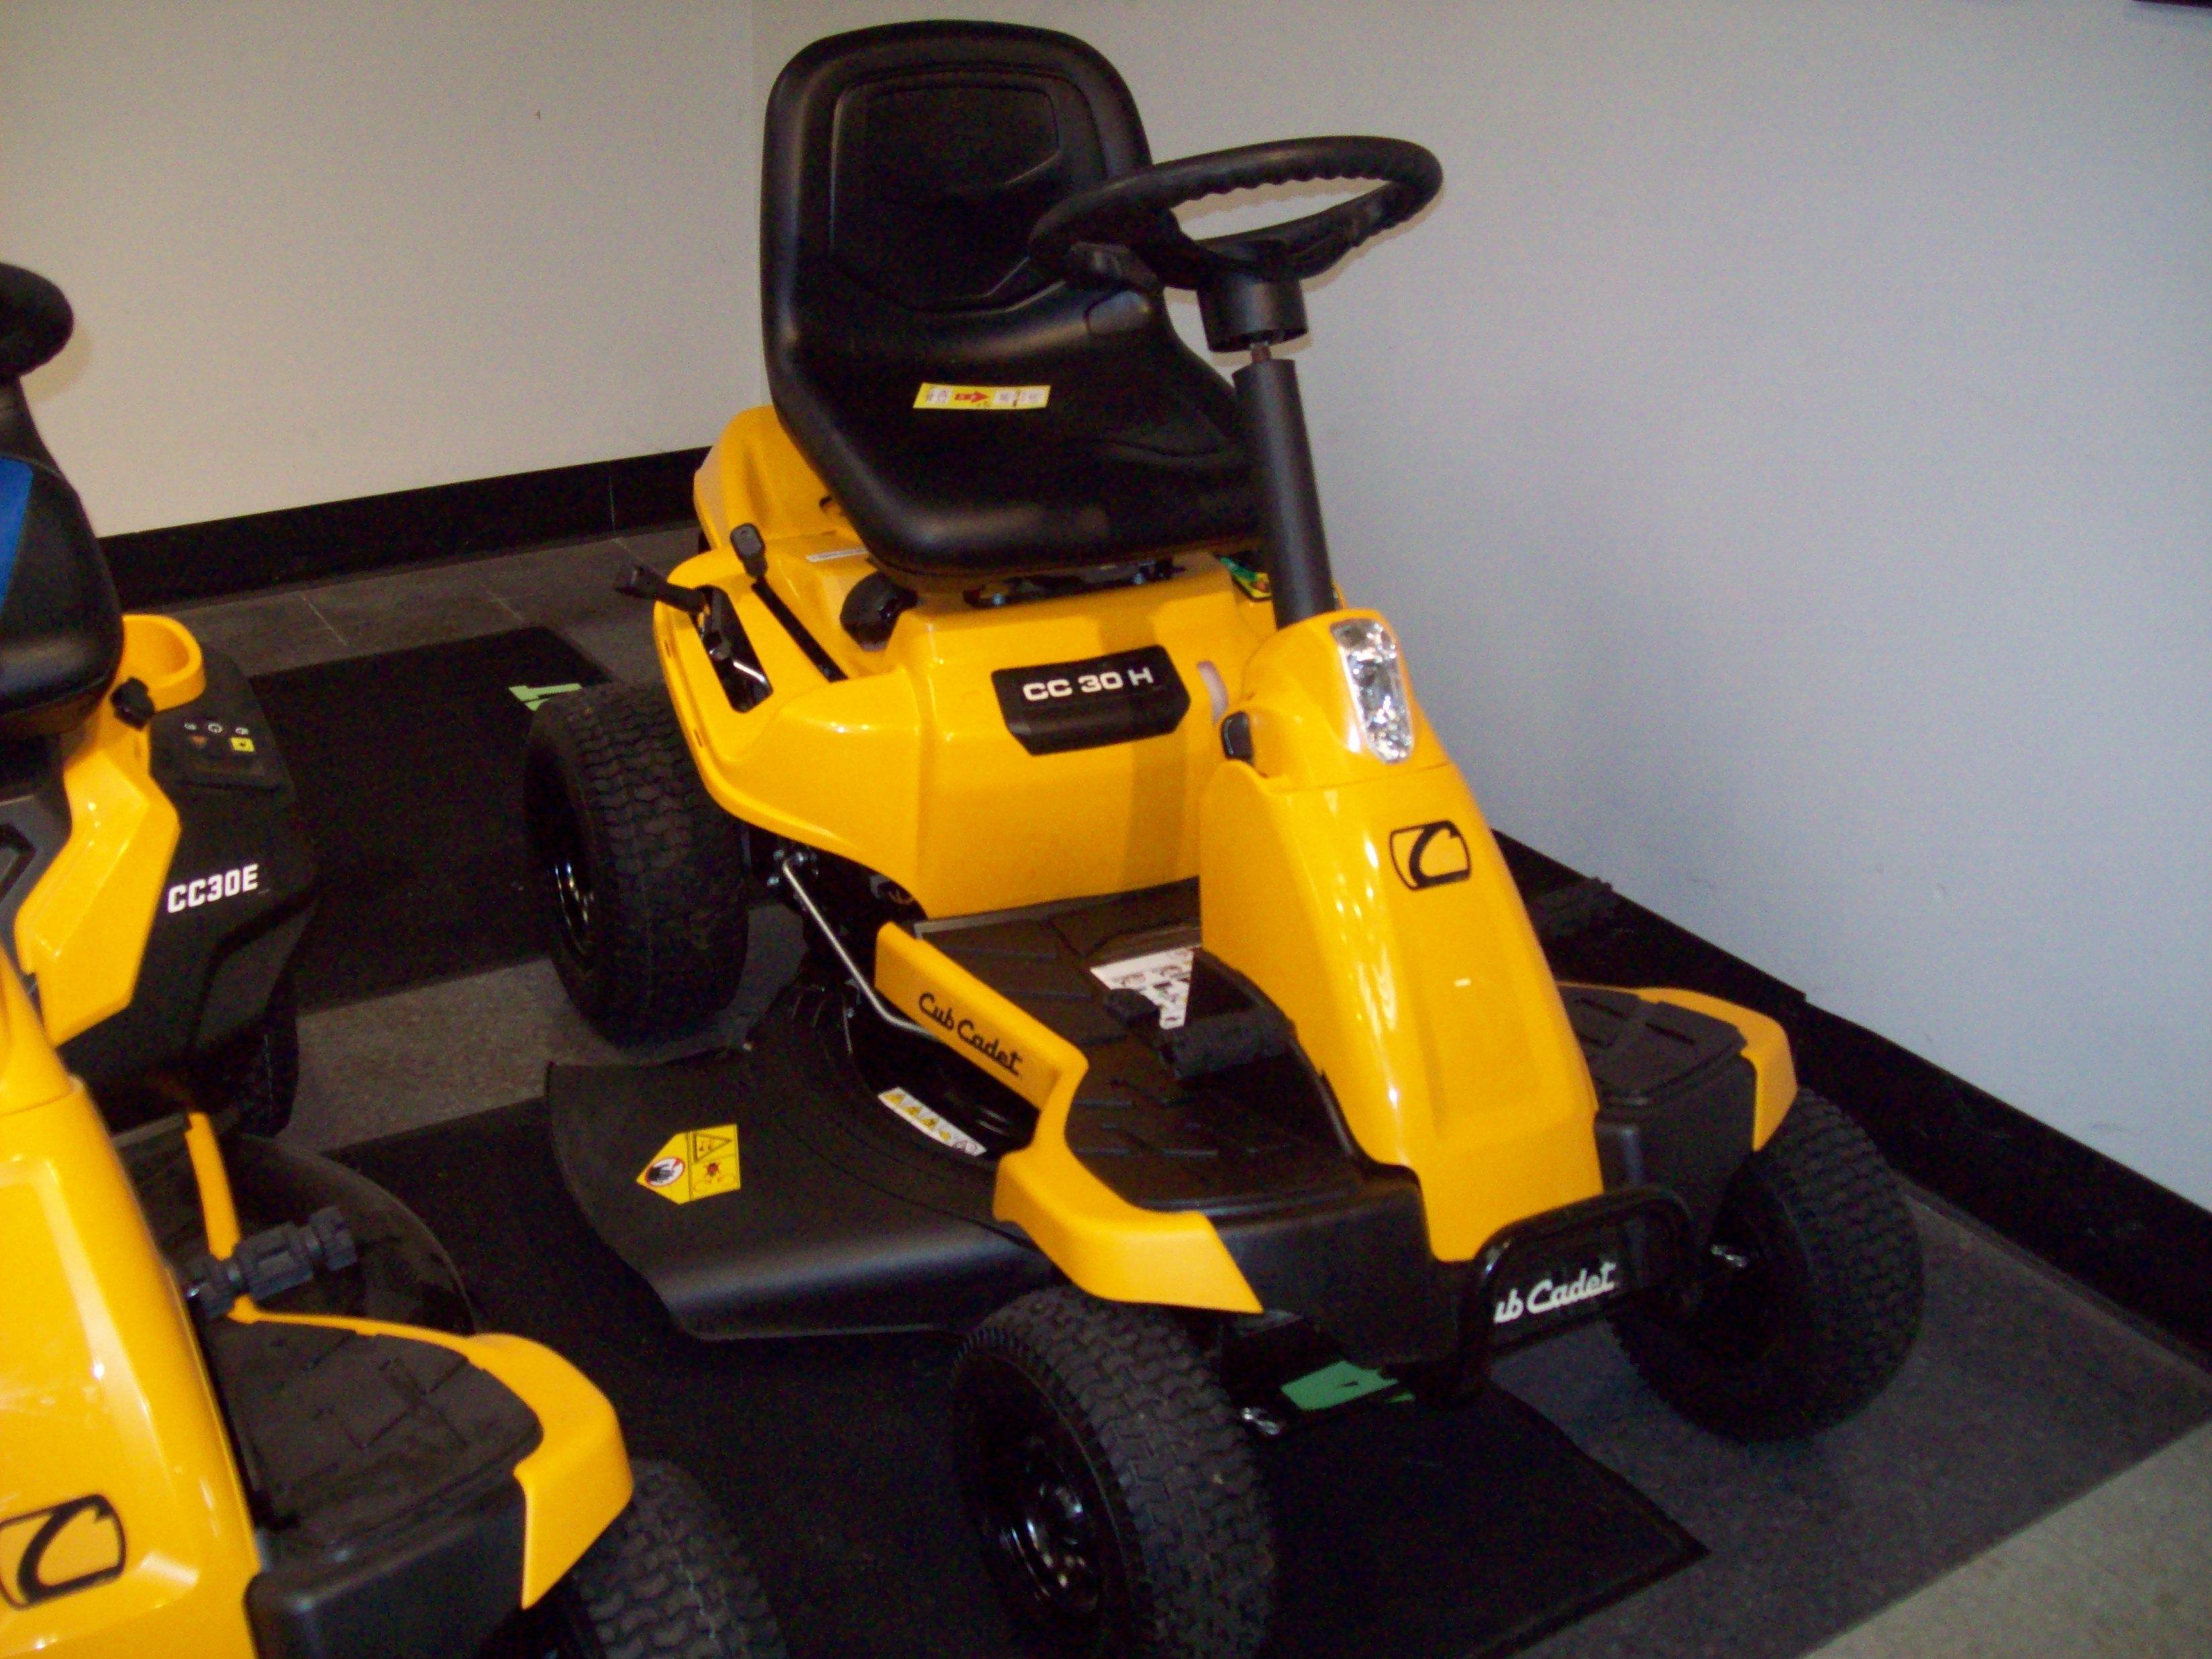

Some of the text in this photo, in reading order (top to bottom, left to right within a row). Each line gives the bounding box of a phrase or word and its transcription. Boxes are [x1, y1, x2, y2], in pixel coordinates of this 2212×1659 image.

[1022, 666, 1154, 701] CC 30 H
[167, 863, 258, 914] CC30E
[919, 993, 1023, 1076] Cub Cadet
[1493, 1261, 1617, 1325] ub Cadet
